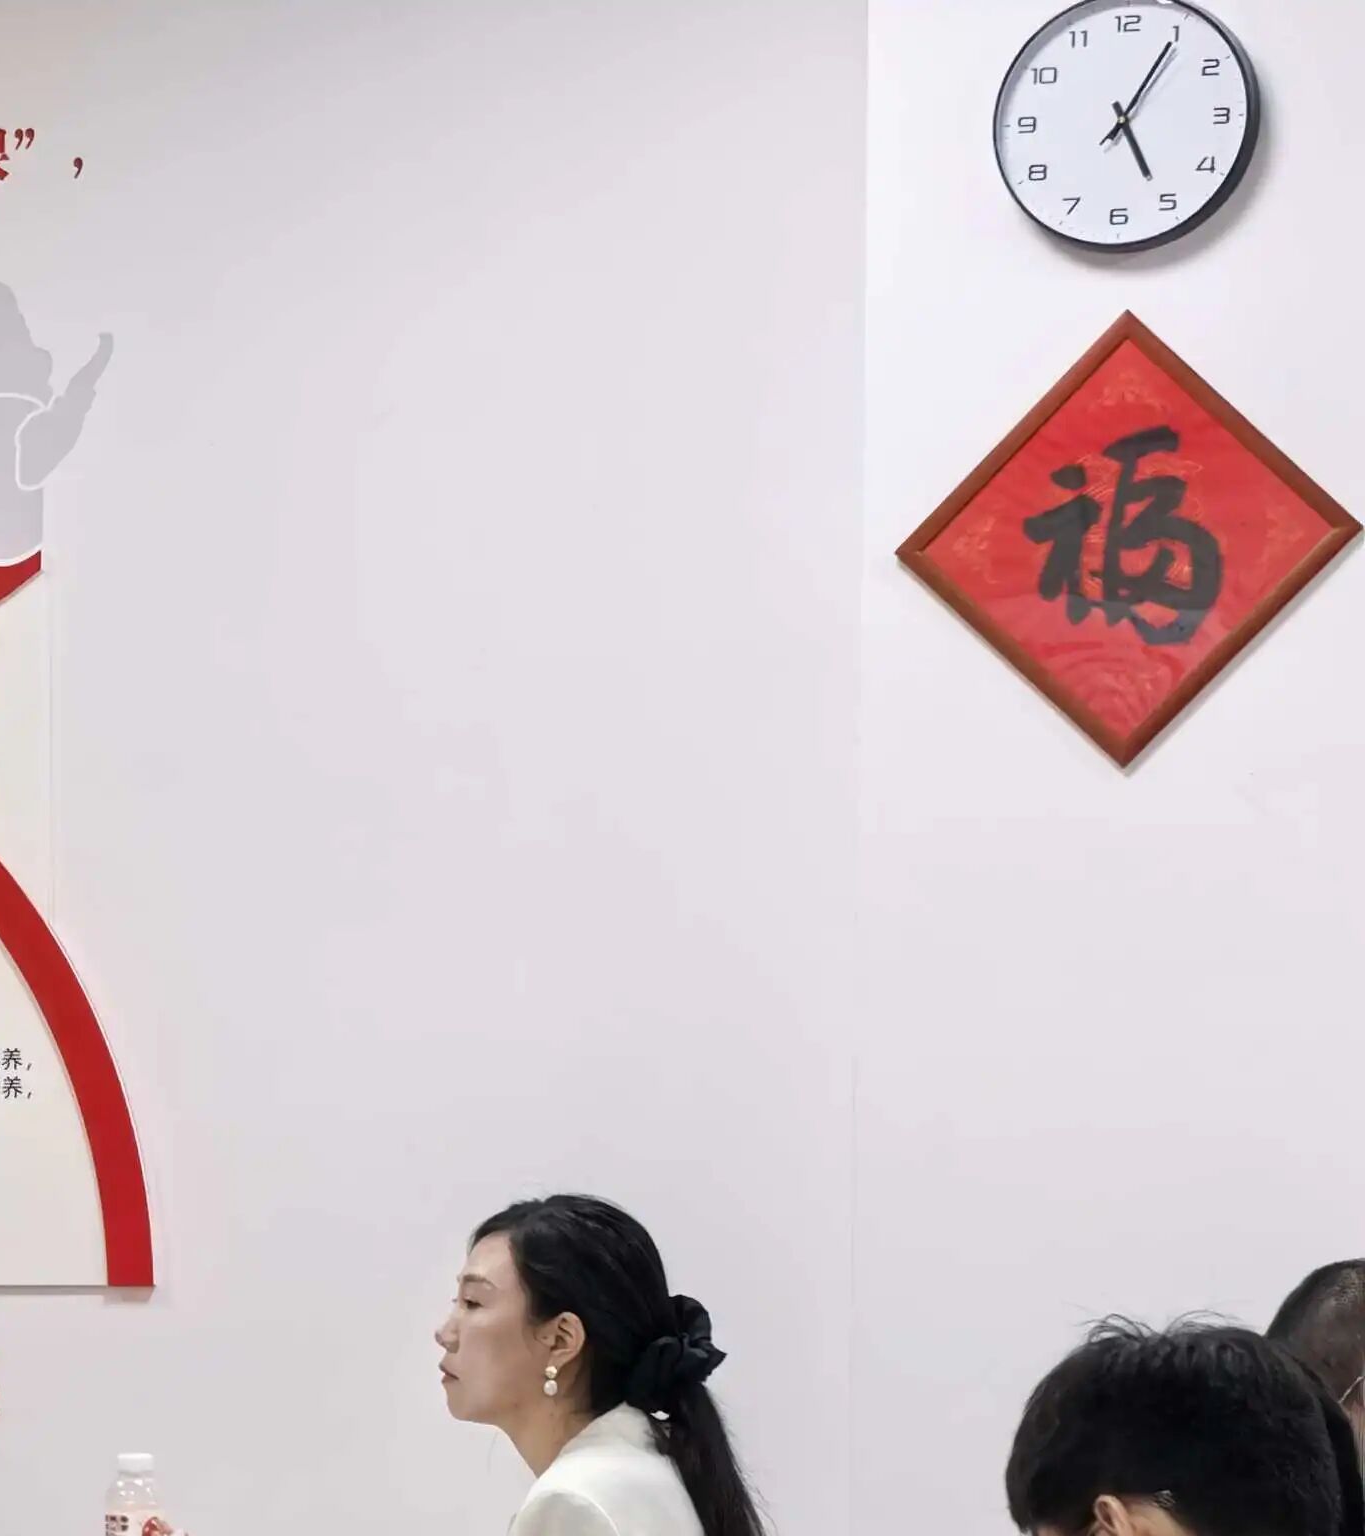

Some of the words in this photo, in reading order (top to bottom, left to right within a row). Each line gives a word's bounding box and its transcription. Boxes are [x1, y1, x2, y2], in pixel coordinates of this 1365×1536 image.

[1114, 15, 1141, 32] 12
[1069, 30, 1088, 48] 11
[1201, 58, 1220, 76] 2
[1031, 67, 1057, 85] 10
[1213, 107, 1230, 124] 3
[1018, 117, 1036, 133] 9
[1028, 164, 1047, 181] 8
[1195, 156, 1215, 173] 4
[1062, 197, 1081, 215] 7
[1158, 193, 1177, 211] 5
[1109, 208, 1128, 225] 6
[1023, 425, 1224, 644] 福
